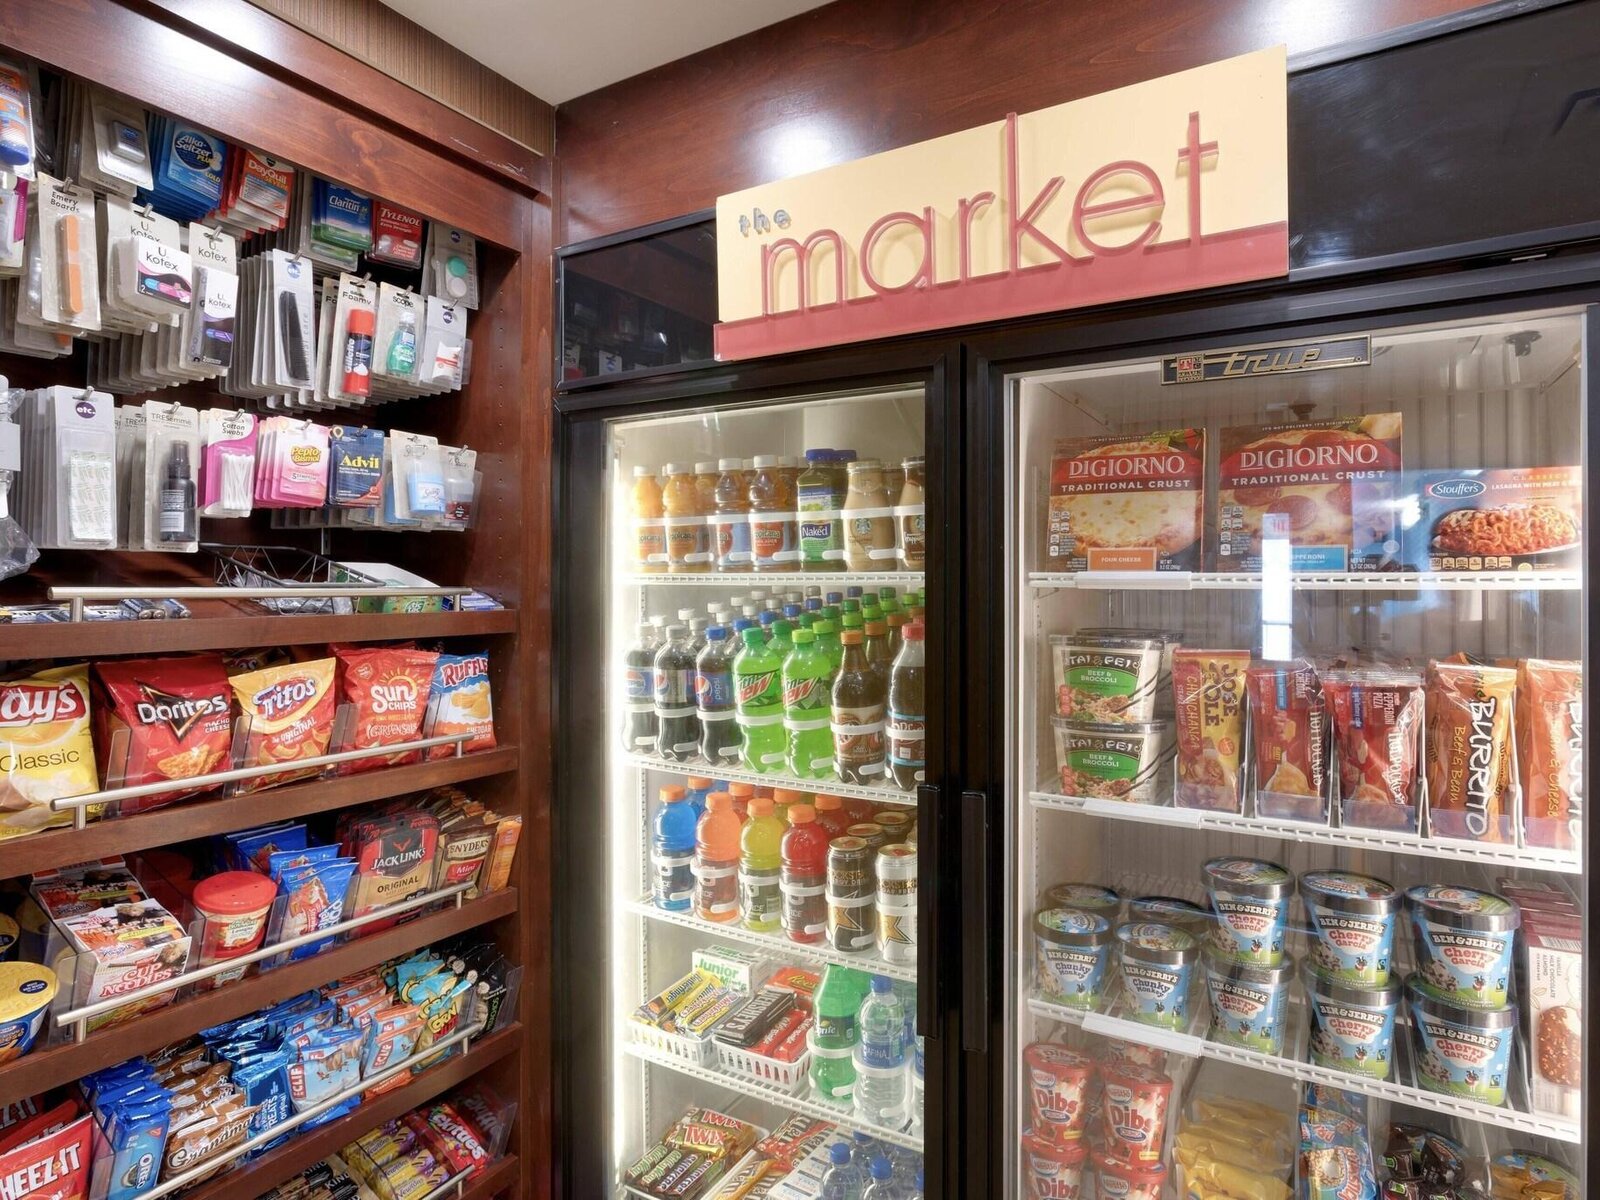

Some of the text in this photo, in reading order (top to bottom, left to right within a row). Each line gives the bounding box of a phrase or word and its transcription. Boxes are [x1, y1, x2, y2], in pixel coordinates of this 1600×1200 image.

[175, 140, 213, 156] Seltzer
[181, 134, 208, 149] Alka-
[249, 160, 287, 185] DayQuil
[51, 191, 79, 207] Emery
[328, 195, 361, 213] Claritin
[380, 207, 422, 227] TYLENOL
[738, 207, 792, 238] the
[762, 111, 1220, 318] market
[140, 284, 146, 294] 2
[342, 290, 372, 305] Foamy
[393, 295, 414, 308] scope
[345, 338, 356, 374] Gillette
[76, 405, 97, 416] etc.
[221, 421, 246, 432] Cotton
[221, 427, 244, 437] Swabs
[291, 447, 320, 458] Pepto
[291, 454, 320, 464] Bismol
[1239, 443, 1379, 471] DIGIORNO
[339, 455, 379, 469] Advil
[1068, 454, 1186, 478] DIGIORNO
[1061, 479, 1191, 493] TRADITIONAL CRUST
[1231, 470, 1386, 486] TRADITIONAL CRUST
[1522, 481, 1541, 489] WITH
[1436, 483, 1479, 495] Stouffer's
[802, 525, 828, 538] Naked
[1069, 655, 1131, 668] TAI PEI
[441, 657, 489, 688] RUFFLE
[1080, 674, 1117, 684] BROCCOLI
[1087, 669, 1105, 677] BEEF
[714, 677, 722, 701] pepsi
[252, 678, 317, 719] Fritos
[370, 684, 410, 714] Sun
[388, 700, 417, 711] CHIPS
[1203, 684, 1225, 727] OLÉ
[1373, 692, 1383, 709] PIZZA
[136, 694, 229, 725] Doritos
[1185, 675, 1201, 748] CHIMICHANGA
[1383, 692, 1394, 725] PEPPERONI
[280, 717, 318, 740] ORIGINAL
[1070, 738, 1133, 751] TAI PEI
[1450, 725, 1466, 755] Beef
[0, 748, 80, 774] Classic
[1082, 759, 1119, 768] BROCCOLI
[1089, 753, 1107, 761] BEEF
[1465, 697, 1496, 836] BURRITO
[1450, 769, 1463, 804] Bean
[1546, 773, 1560, 818] Cheese
[371, 848, 427, 870] JACK LINK'S
[376, 876, 420, 893] ORIGINAL
[1219, 902, 1236, 912] BEN
[1244, 904, 1278, 917] JERRY'S
[1227, 914, 1270, 928] Cherry
[1233, 922, 1267, 933] Garcia
[1320, 917, 1339, 927] BEN
[1347, 919, 1385, 933] JERRY'S
[1328, 930, 1376, 947] Cherry
[1335, 939, 1367, 950] Garcia
[1434, 933, 1456, 944] BEN
[1465, 936, 1505, 951] JERRY'S
[1048, 951, 1062, 959] BEN
[1068, 953, 1097, 965] JERRY'S
[1443, 947, 1494, 962] Cherry
[1450, 956, 1486, 969] Garcia
[122, 961, 164, 982] CUP
[699, 958, 739, 978] Junior
[1055, 962, 1091, 975] Chunky
[1059, 969, 1086, 980] Monkey
[1125, 966, 1139, 975] BEN
[1145, 968, 1179, 984] JERRY'S
[99, 969, 173, 998] NOODLES
[665, 972, 703, 1004] Butterfinger
[1132, 978, 1171, 993] Chunky
[1136, 986, 1165, 999] Monkey
[1211, 980, 1226, 990] BEN
[1231, 983, 1268, 1002] JERRY'S
[725, 990, 783, 1031] HERSHEY'S
[1217, 992, 1258, 1011] Cherry
[1222, 1002, 1249, 1016] Garcia
[1320, 1004, 1340, 1015] BEN
[1348, 1008, 1385, 1024] JERRY'S
[1329, 1017, 1376, 1035] Cherry
[1335, 1027, 1367, 1040] Garcia
[1427, 1023, 1448, 1036] BEN
[1456, 1029, 1498, 1048] JERRY'S
[863, 1046, 890, 1060] AFINA
[1436, 1039, 1486, 1058] Cherry
[1443, 1049, 1478, 1064] Garcia
[291, 1066, 304, 1092] CLIF
[1034, 1088, 1079, 1114] Dibs
[701, 1109, 743, 1130] TWIX
[1109, 1104, 1155, 1131] Dibs
[683, 1124, 727, 1146] TWIX
[0, 1142, 82, 1200] HEEZ-IT
[136, 1153, 154, 1189] OREO
[660, 1154, 697, 1191] SNICKERS
[676, 1160, 712, 1194] SNICKERS
[325, 1172, 351, 1189] KIND
[1036, 1176, 1080, 1197] Dibs
